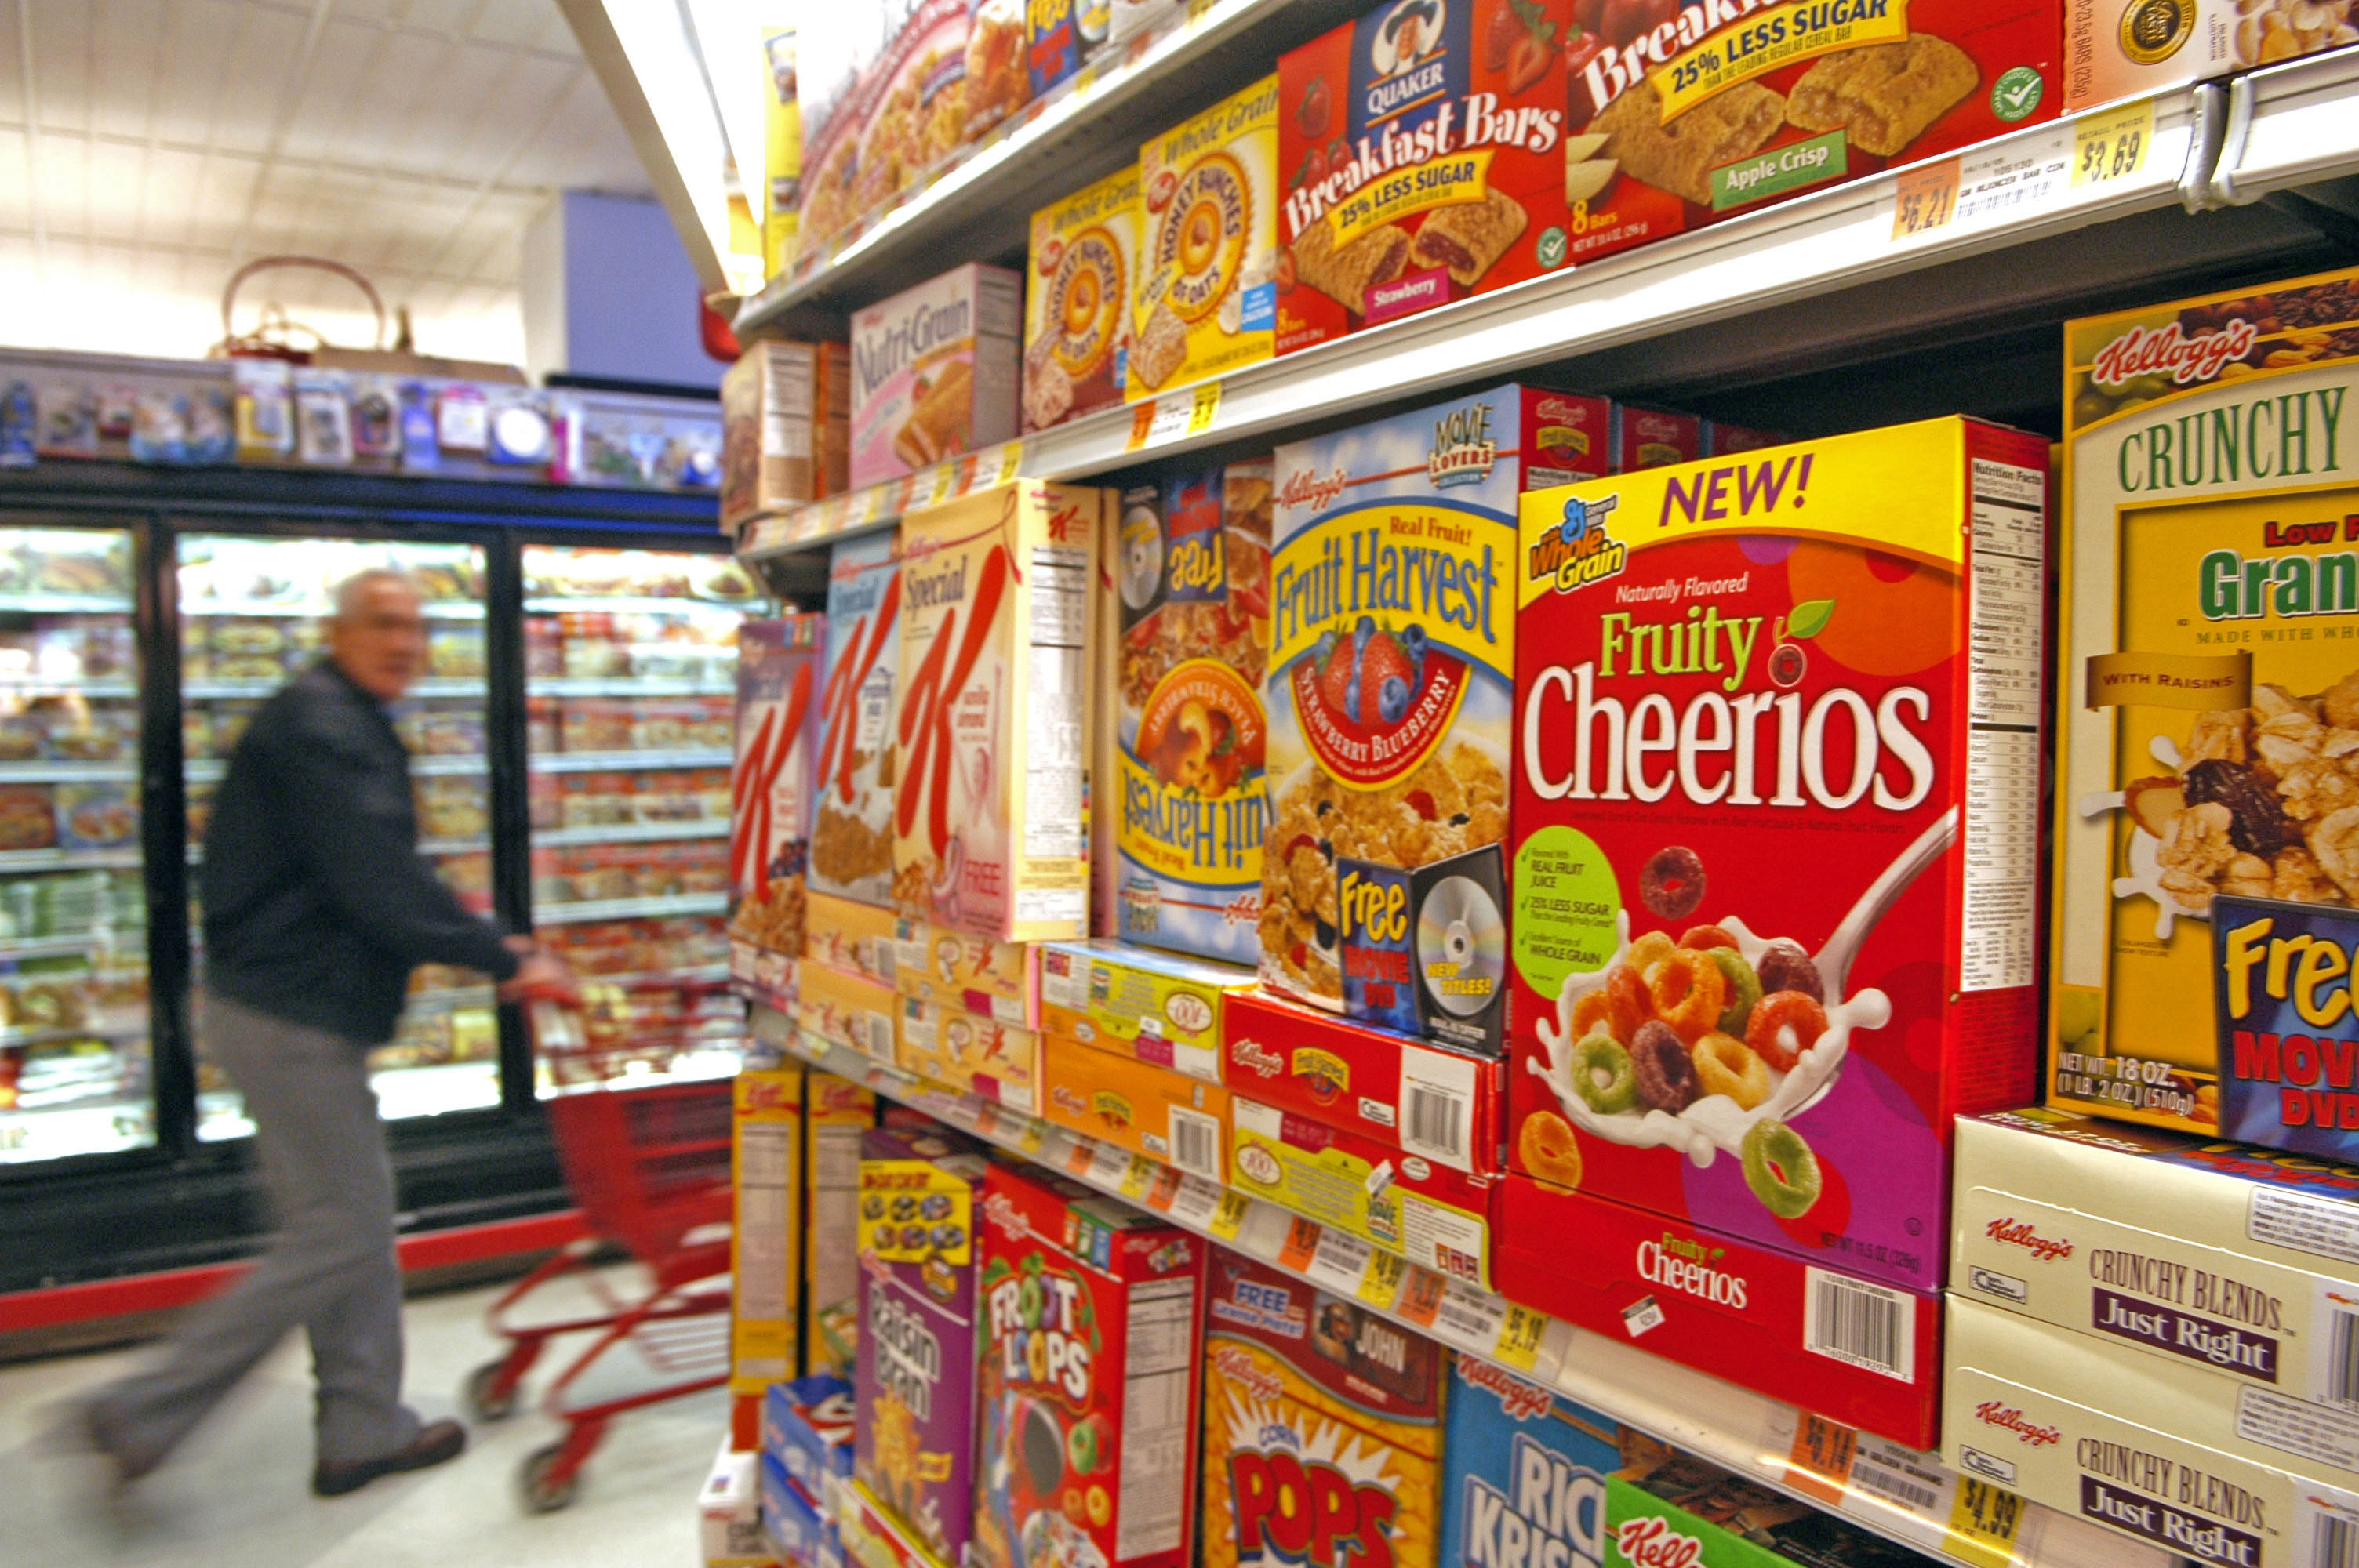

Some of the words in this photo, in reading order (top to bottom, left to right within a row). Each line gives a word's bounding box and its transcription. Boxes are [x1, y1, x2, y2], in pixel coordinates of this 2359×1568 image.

[1670, 47, 1720, 93] 25%
[1725, 16, 1787, 64] LESS
[2074, 34, 2093, 66] BARS
[1366, 62, 1445, 115] QUAKER
[1281, 99, 1456, 238] Breakfast
[1461, 91, 1562, 153] Bars
[1725, 162, 1779, 193] Apple
[1779, 143, 1830, 172] Crisp
[2081, 129, 2143, 183] $3.69
[1161, 177, 1197, 264] HONEY
[1197, 165, 1243, 238] BUNCHES
[1340, 196, 1372, 229] 25%
[1372, 175, 1413, 209] LESS
[1415, 160, 1477, 191] SUGAR
[1572, 198, 1588, 235] 8
[1589, 211, 1619, 230] Bars
[1899, 184, 1952, 234] $6.21
[1372, 276, 1438, 308] Strawberry
[2091, 318, 2257, 385] Kellogg's
[1434, 401, 1495, 454] MOVIE
[2119, 384, 2349, 494] CRUNCHY
[1279, 467, 1347, 511] Kellogg's
[1430, 448, 1492, 474] LOVERS
[1972, 462, 2016, 480] Nutrition
[1658, 452, 1816, 529] NEW!
[1389, 514, 1424, 536] Real
[1427, 516, 1473, 547] Fruit!
[1529, 526, 1606, 582] Whole
[2265, 520, 2338, 550] Low
[905, 553, 969, 622] Special
[1169, 532, 1224, 593] Free
[1555, 539, 1626, 593] Grain
[1616, 576, 1682, 604] Naturally
[1683, 571, 1750, 597] Flavored
[1272, 535, 1345, 655] Fruit
[1348, 527, 1499, 645] Harvest
[1598, 604, 1764, 693] Fruity
[2197, 630, 2252, 645] MADE
[2260, 627, 2314, 641] WITH
[896, 545, 1007, 860] K
[2103, 673, 2151, 690] WITH
[2156, 673, 2236, 691] RAISINS
[1371, 666, 1452, 763] BLUEBERRY
[1522, 661, 1936, 811] Cheerios
[731, 662, 814, 905] K
[1123, 765, 1219, 869] Harvest
[1221, 793, 1265, 872] uit
[1530, 874, 1557, 889] JUICE
[1531, 859, 1554, 873] REAL
[1555, 862, 1585, 876] FRUIT
[1339, 870, 1411, 942] Free
[1549, 898, 1571, 913] LESS
[1572, 900, 1611, 917] SUGAR
[1344, 944, 1411, 985] MOVIE
[1425, 961, 1460, 979] NEW
[1529, 943, 1566, 961] WHOLE
[1566, 949, 1602, 966] GRAIN
[1440, 976, 1492, 996] TITLES!
[2058, 1051, 2085, 1074] NET
[2085, 1055, 2111, 1079] WT.
[2115, 1055, 2140, 1082] 18
[2140, 1062, 2179, 1089] OZ.
[2232, 1029, 2359, 1089] MOV
[2074, 1076, 2095, 1097] LB.
[2097, 1080, 2112, 1098] 2
[2143, 1083, 2195, 1118] (510g)
[1661, 1232, 1709, 1266] Fruity
[1985, 1216, 2077, 1262] Kellogg's
[1236, 1279, 1290, 1313] FREE
[1636, 1239, 1749, 1311] Cheerios
[2088, 1247, 2186, 1306] CRUNCHY
[2193, 1268, 2284, 1332] BLENDS
[989, 1272, 1079, 1341] FROOT
[2098, 1294, 2173, 1344] Just
[2175, 1316, 2270, 1365] Right
[1002, 1329, 1090, 1401] LOOPS
[1216, 1345, 1284, 1402] Kellogg's
[1355, 1319, 1407, 1375] JOHN
[1456, 1350, 1555, 1422] Kellogg's
[1257, 1423, 1301, 1451] CORN
[1975, 1399, 2063, 1447] Kellogg's
[1230, 1449, 1402, 1568] POPS
[1514, 1436, 1606, 1560] RIC
[2076, 1436, 2173, 1494] CRUNCHY
[2178, 1457, 2267, 1532] BLENDS
[2086, 1482, 2157, 1531] Just
[2160, 1508, 2256, 1567] Right
